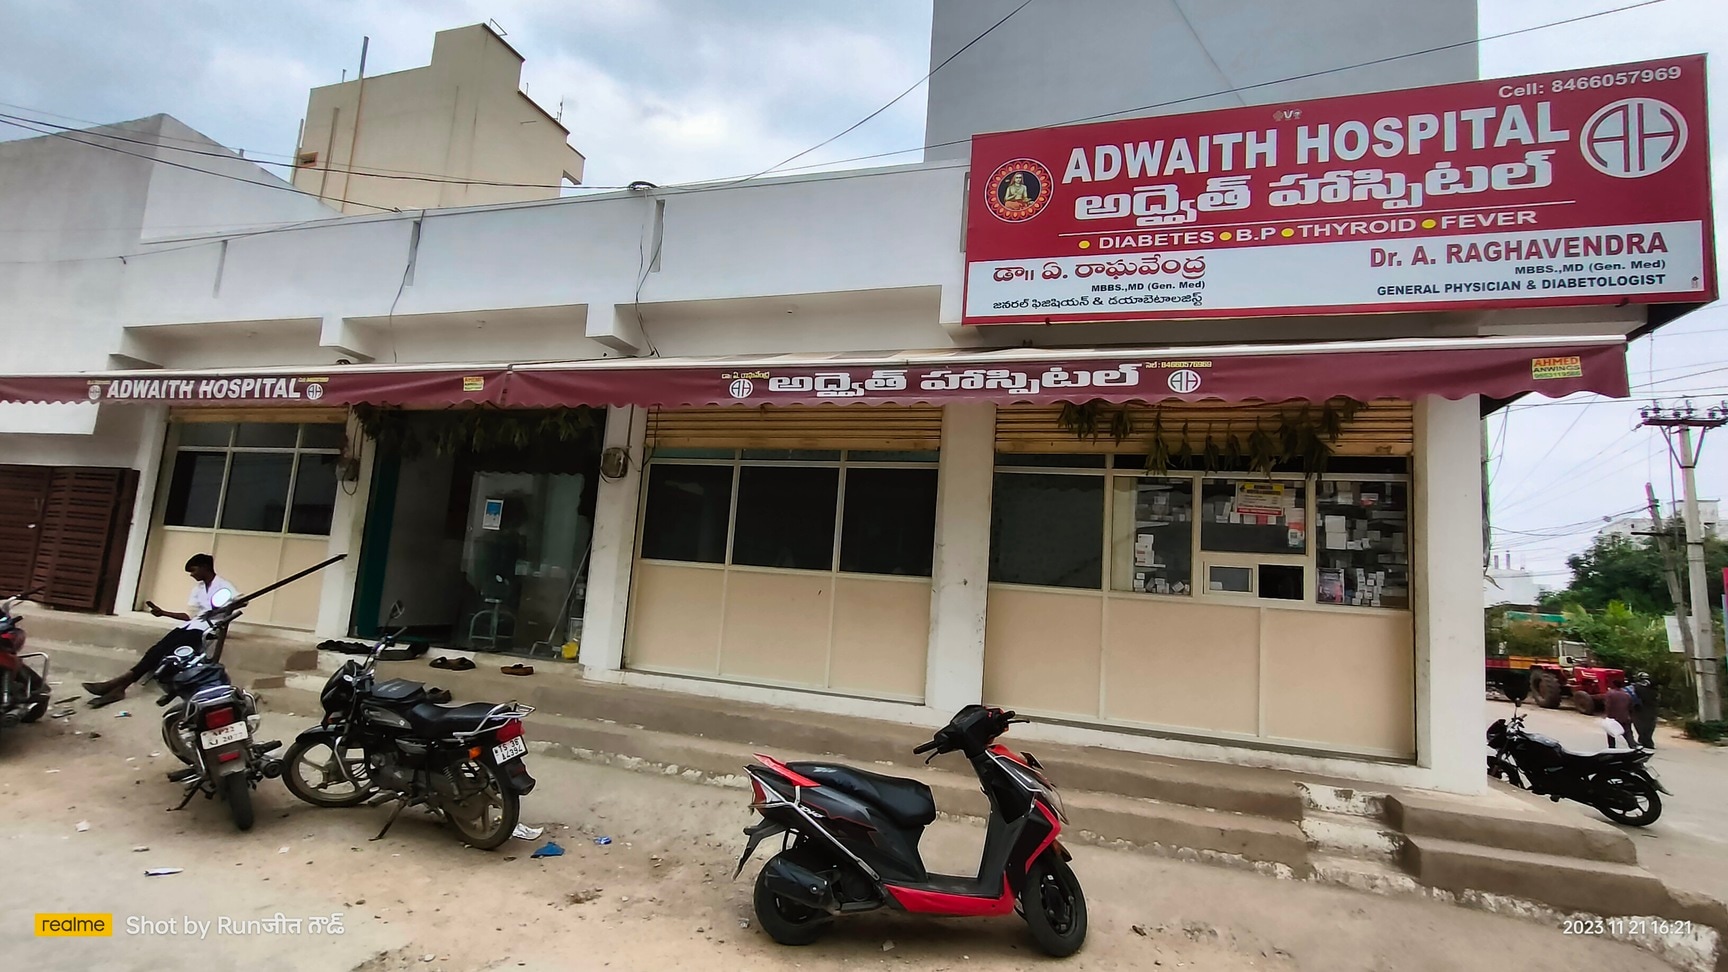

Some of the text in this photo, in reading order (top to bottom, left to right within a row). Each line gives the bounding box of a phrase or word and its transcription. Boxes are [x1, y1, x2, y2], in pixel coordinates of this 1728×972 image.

[1498, 66, 1682, 98] Cell: 8466057969
[1061, 101, 1570, 184] ADWAITH HOSPITAL
[1074, 149, 1556, 227] అద్వైత్ హాస్పిటల్
[1099, 210, 1538, 249] DIABETES B.P THYROID FEVER
[1370, 232, 1668, 267] Dr. A. RAGHAVENDRA
[1074, 253, 1206, 280] రాఘవేంద్ర
[1589, 262, 1626, 273] (Gen.
[1631, 259, 1666, 270] Med)
[1147, 282, 1175, 292] (Gen.
[1178, 280, 1206, 290] Med)
[1377, 274, 1666, 296] GENERAL PHYSICIAN & DIABETOLOGIST
[993, 298, 1029, 310] జనరల్
[1093, 297, 1104, 306] &
[1534, 357, 1579, 367] AHMED
[106, 380, 196, 399] ADWAITH
[198, 377, 301, 399] HOSPITAL
[768, 363, 1143, 398] అద్వైత్ హాస్పిటల్
